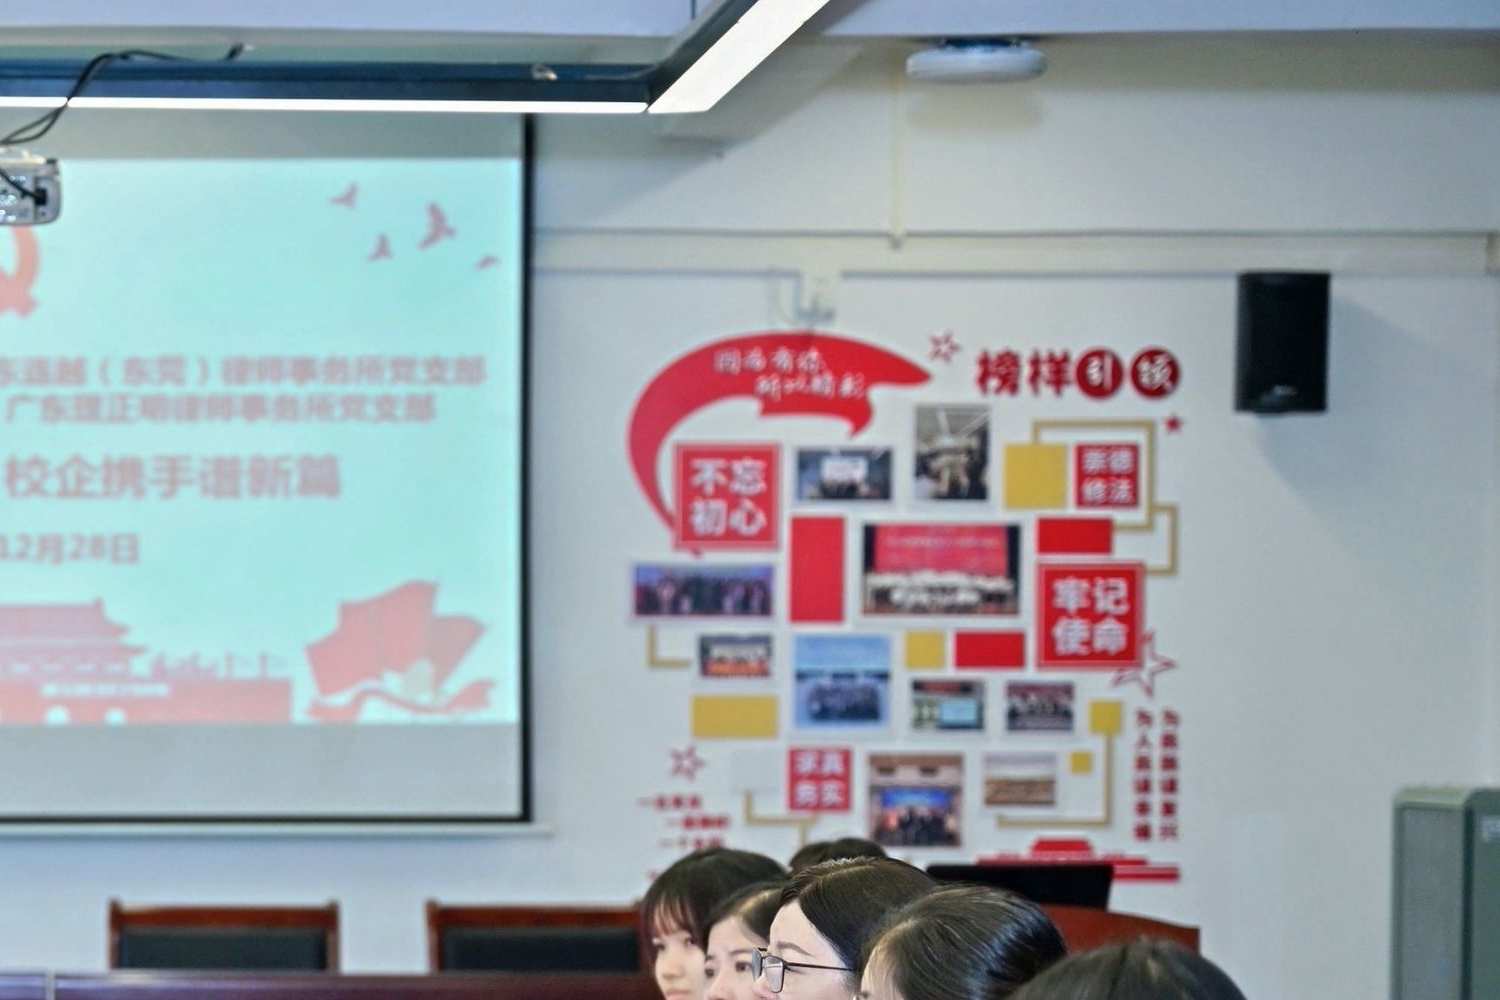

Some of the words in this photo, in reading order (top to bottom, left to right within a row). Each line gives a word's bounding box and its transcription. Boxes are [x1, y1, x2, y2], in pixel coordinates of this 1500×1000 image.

[977, 347, 1180, 398] 榜样引领
[4, 453, 343, 501] 校企携手谱新篇
[691, 457, 768, 495] 不忘
[691, 500, 768, 537] 初心
[1051, 576, 1130, 614] 牢记
[1051, 618, 1130, 657] 使命
